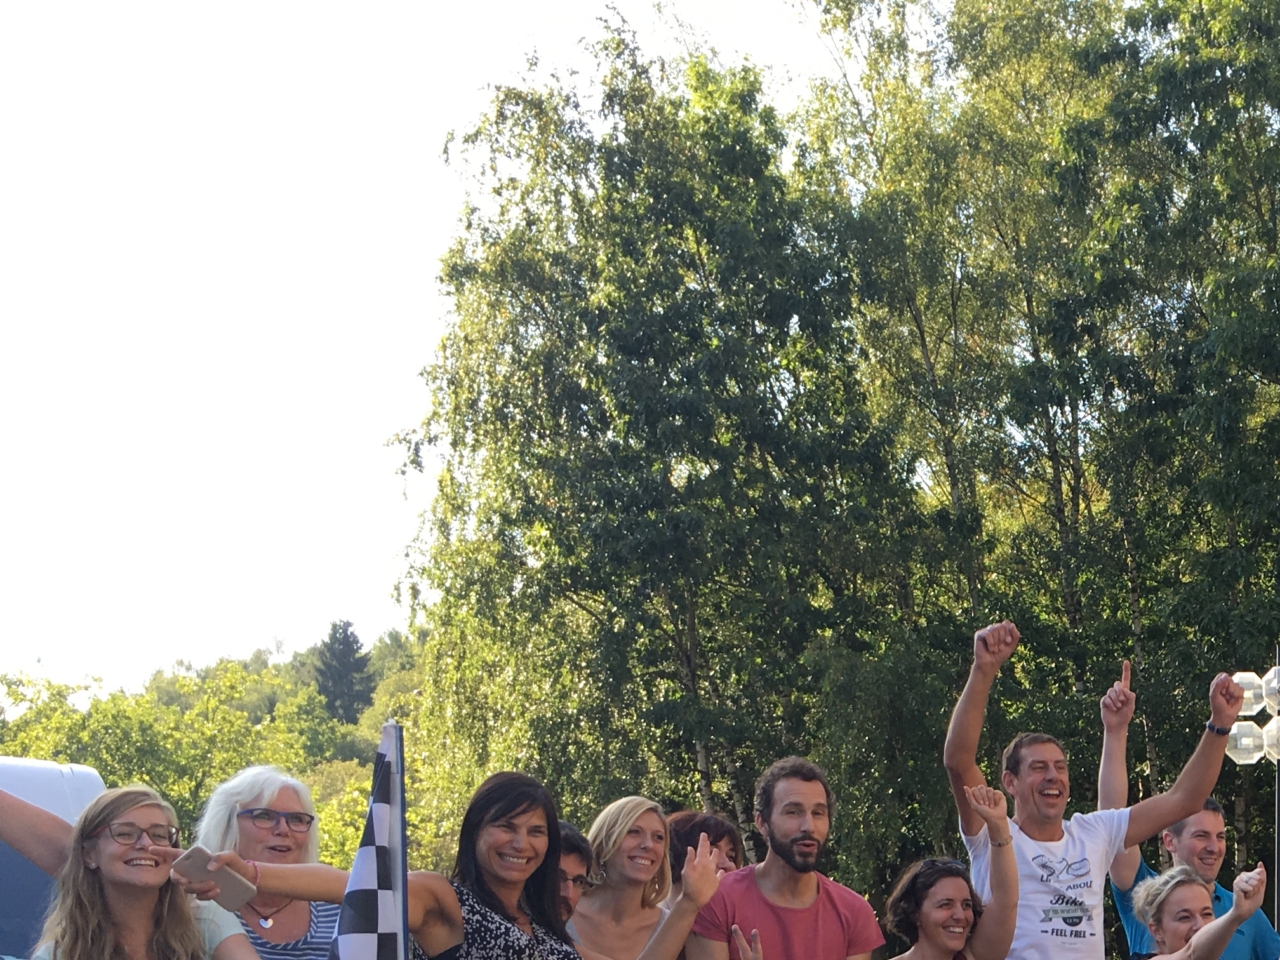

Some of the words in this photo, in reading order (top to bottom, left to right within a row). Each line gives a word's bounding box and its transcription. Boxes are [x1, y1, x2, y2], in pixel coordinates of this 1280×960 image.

[1065, 880, 1093, 891] ABOU
[1050, 928, 1068, 938] FEEL
[1070, 929, 1087, 939] FREE
